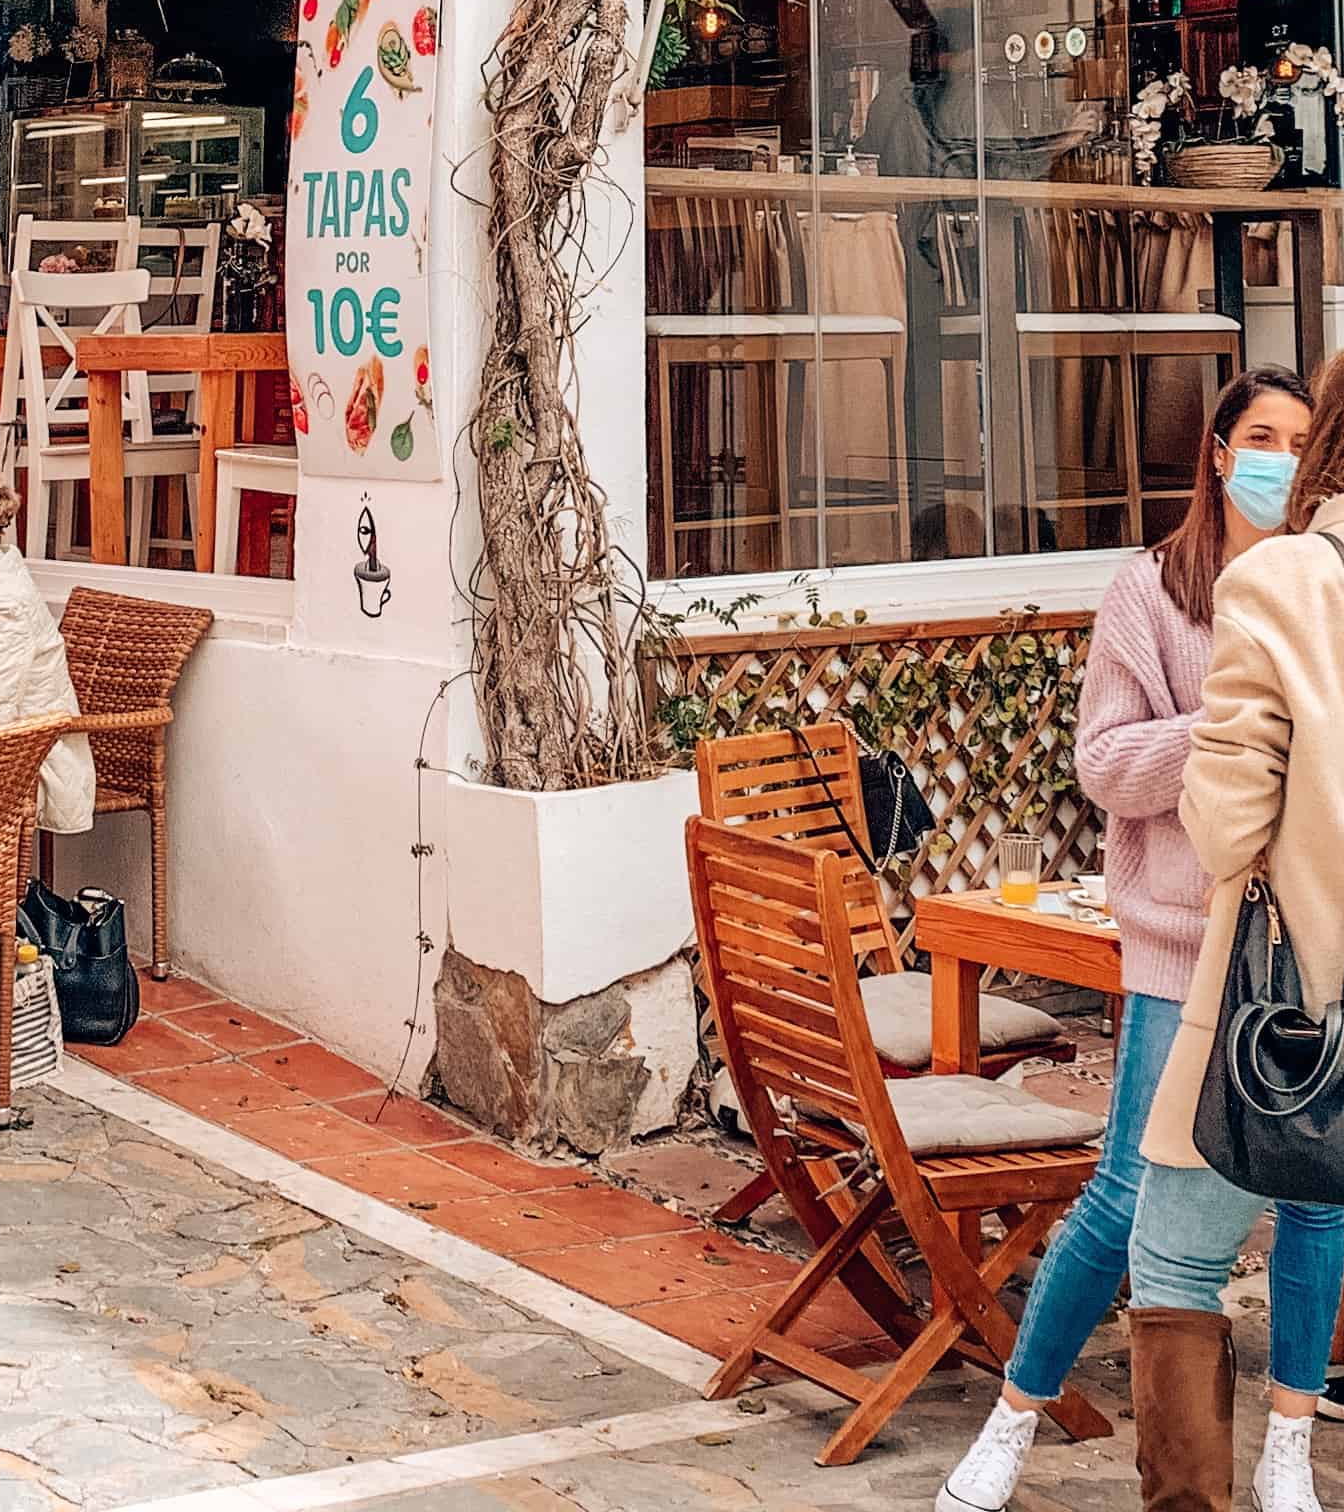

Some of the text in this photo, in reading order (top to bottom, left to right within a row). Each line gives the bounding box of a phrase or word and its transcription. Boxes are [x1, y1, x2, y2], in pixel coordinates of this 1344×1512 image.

[341, 65, 379, 155] 6
[303, 168, 411, 239] TAPAS
[335, 252, 370, 274] POR
[308, 287, 404, 358] 10€
